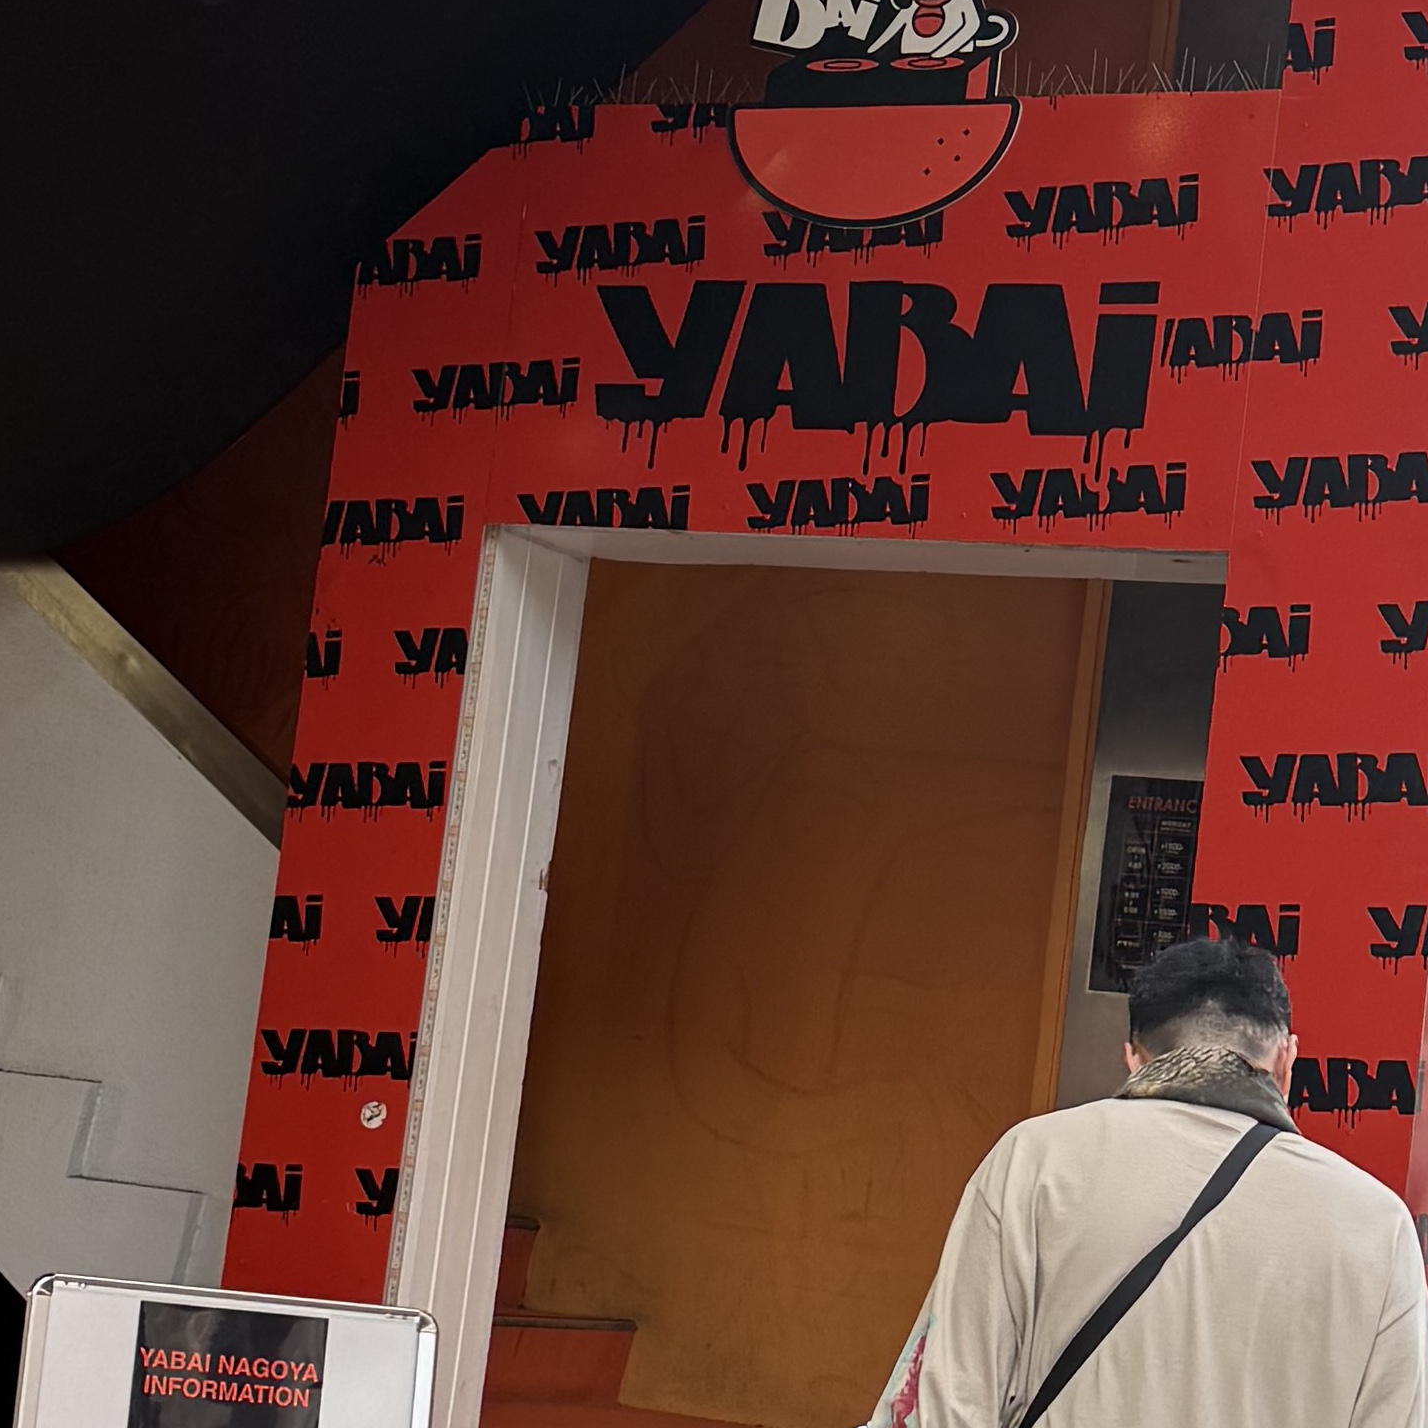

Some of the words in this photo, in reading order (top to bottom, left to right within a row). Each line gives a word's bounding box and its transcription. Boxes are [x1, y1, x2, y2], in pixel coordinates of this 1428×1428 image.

[139, 1347, 211, 1373] YABAI
[218, 1355, 319, 1383] NAGOYA
[143, 1375, 310, 1408] INFORMATION
